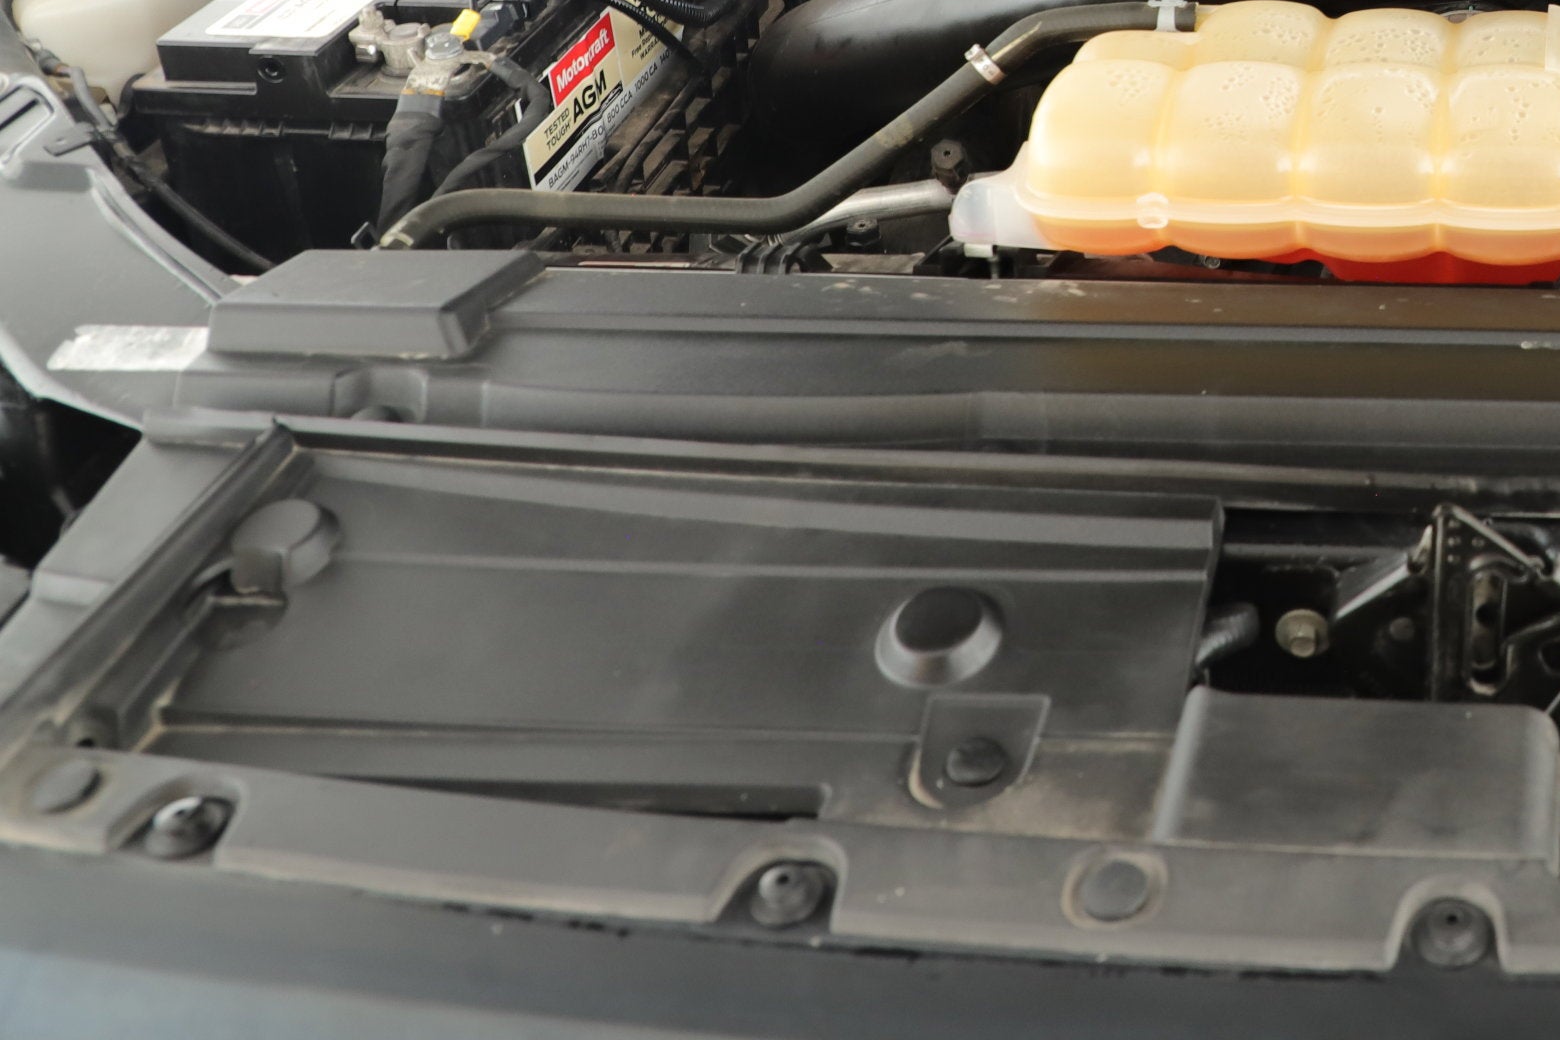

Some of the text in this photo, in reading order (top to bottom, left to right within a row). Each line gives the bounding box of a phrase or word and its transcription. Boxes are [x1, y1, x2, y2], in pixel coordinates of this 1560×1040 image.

[572, 70, 607, 124] AGM
[619, 91, 633, 109] CCA
[634, 74, 649, 91] 1000
[649, 62, 658, 76] CA
[544, 108, 570, 139] TESTED
[546, 122, 571, 150] TOUGH
